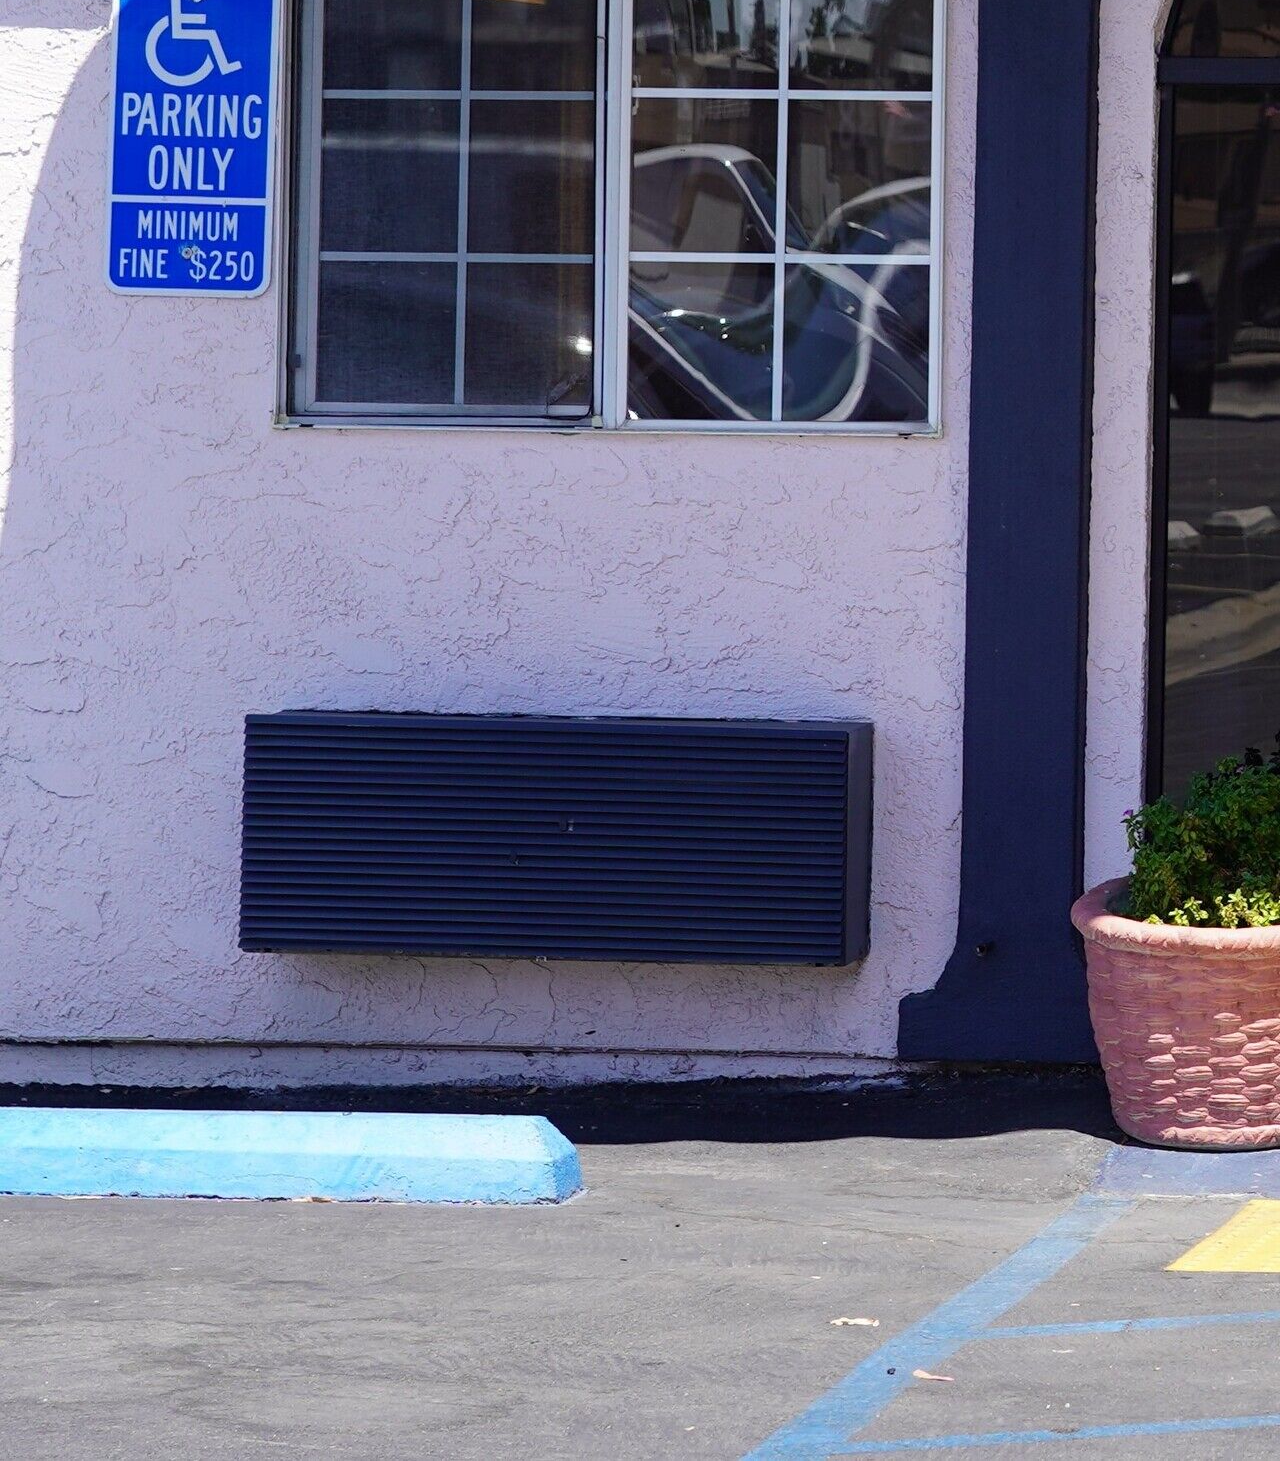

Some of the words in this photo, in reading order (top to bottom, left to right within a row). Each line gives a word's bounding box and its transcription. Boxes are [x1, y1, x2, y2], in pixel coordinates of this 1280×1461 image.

[121, 92, 262, 139] PARKING
[148, 144, 235, 191] ONLY
[137, 209, 238, 242] MINIMUM
[119, 248, 168, 279] FINE
[189, 249, 254, 282] $250
